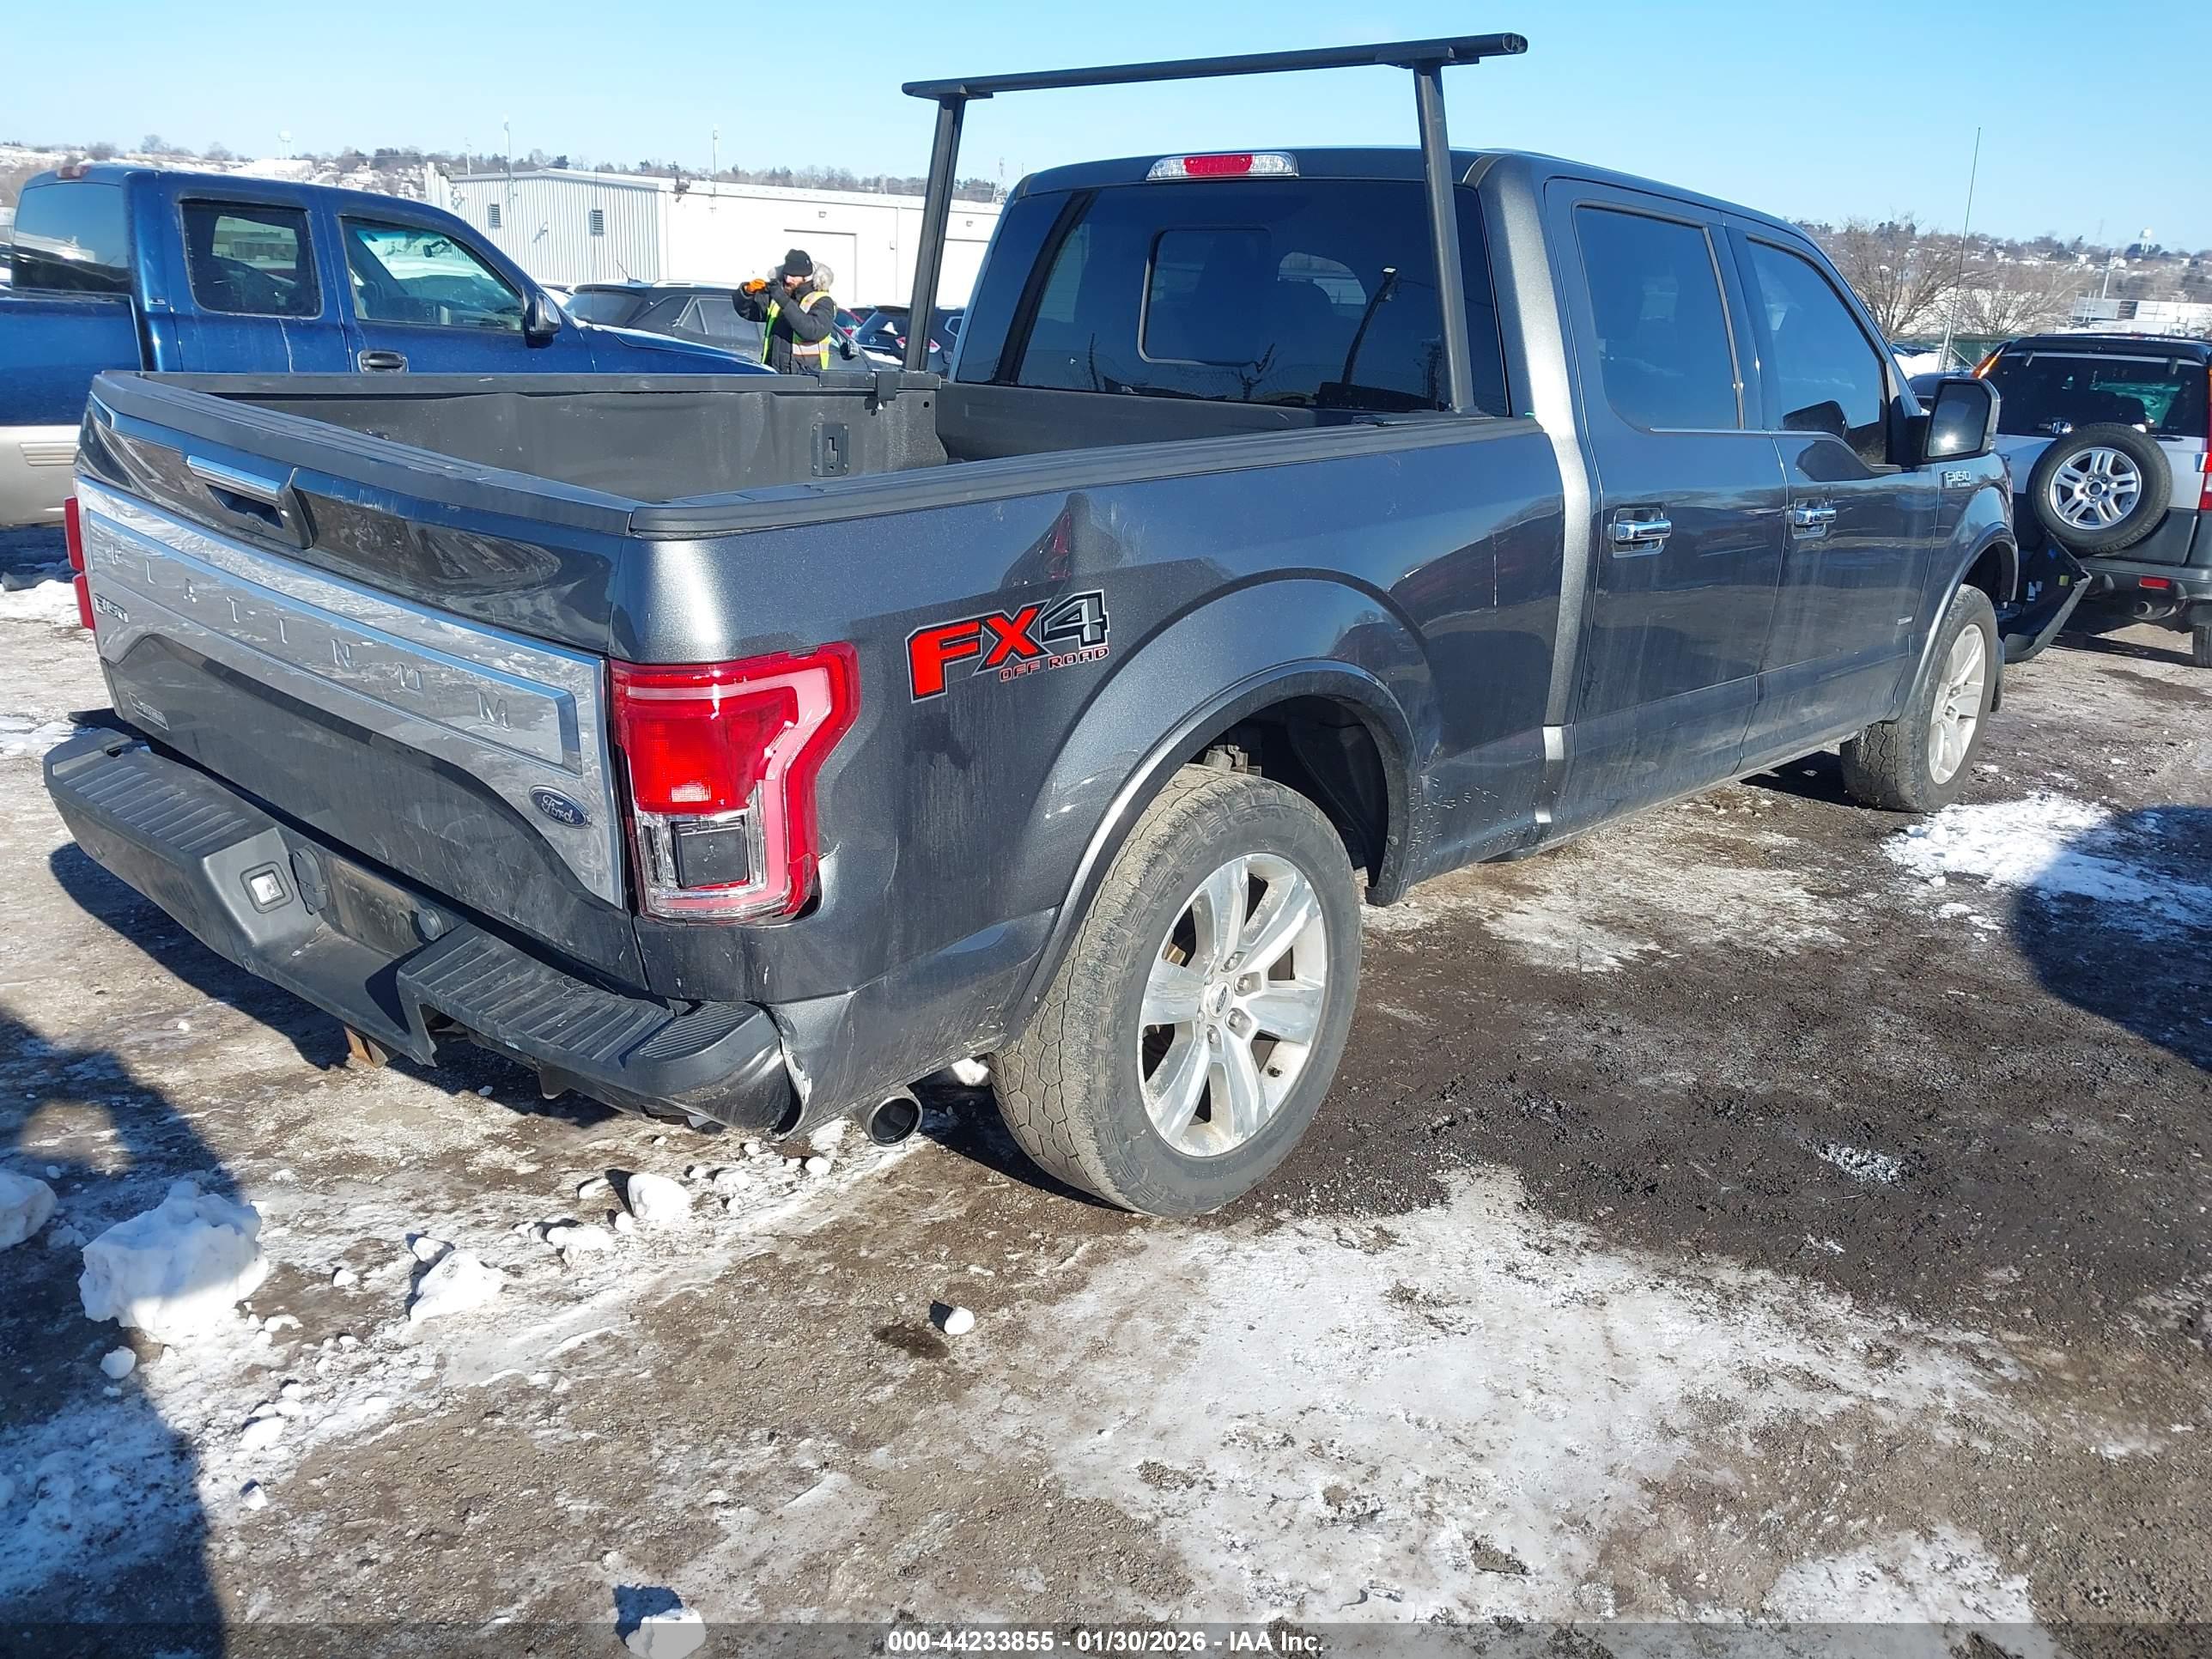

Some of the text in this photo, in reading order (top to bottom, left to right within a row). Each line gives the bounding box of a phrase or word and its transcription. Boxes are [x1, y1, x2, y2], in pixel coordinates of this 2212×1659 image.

[905, 589, 1110, 704] FX4
[999, 646, 1111, 684] OFF ROAD
[540, 793, 576, 824] Ford
